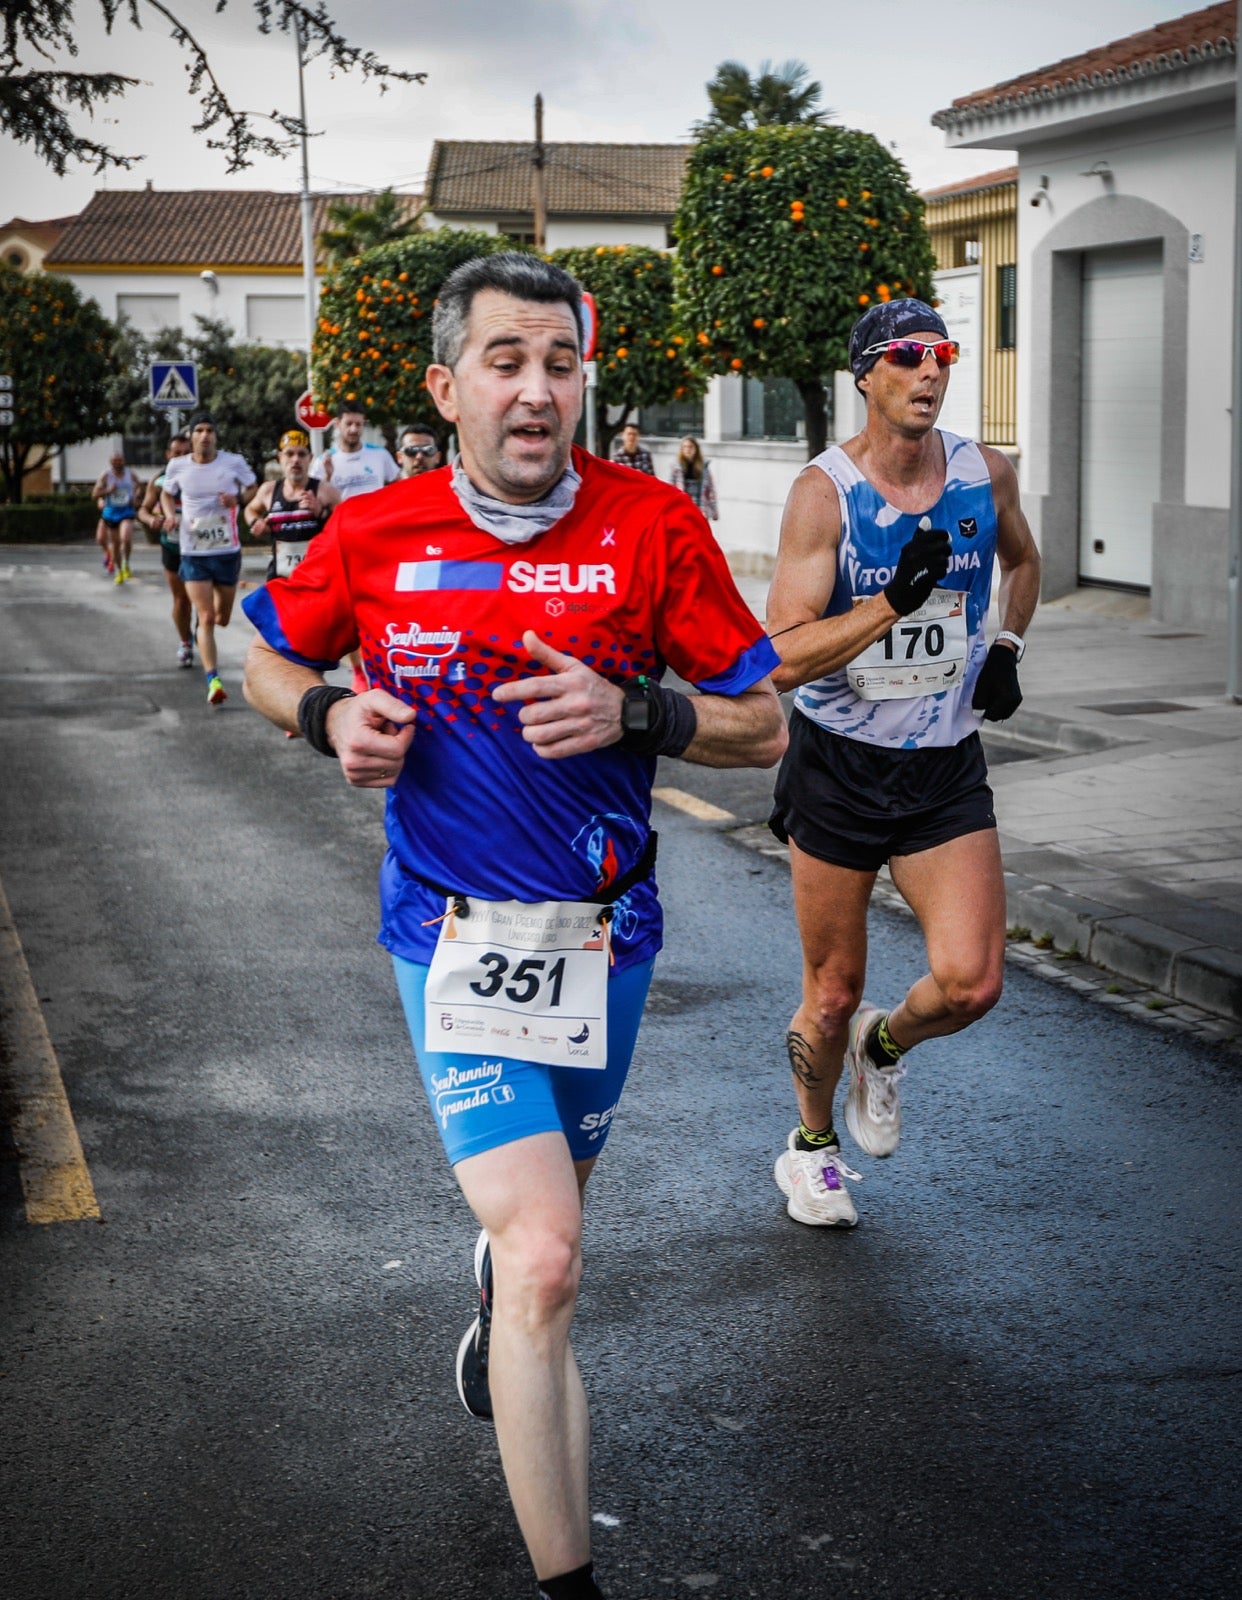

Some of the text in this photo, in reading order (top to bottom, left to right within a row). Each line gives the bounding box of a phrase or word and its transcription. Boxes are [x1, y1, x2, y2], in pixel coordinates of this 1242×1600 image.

[507, 561, 616, 594] SEUR
[876, 624, 944, 660] 170
[469, 952, 567, 1007] 351
[430, 1061, 503, 1095] SeuRunning
[436, 1088, 490, 1130] Granada
